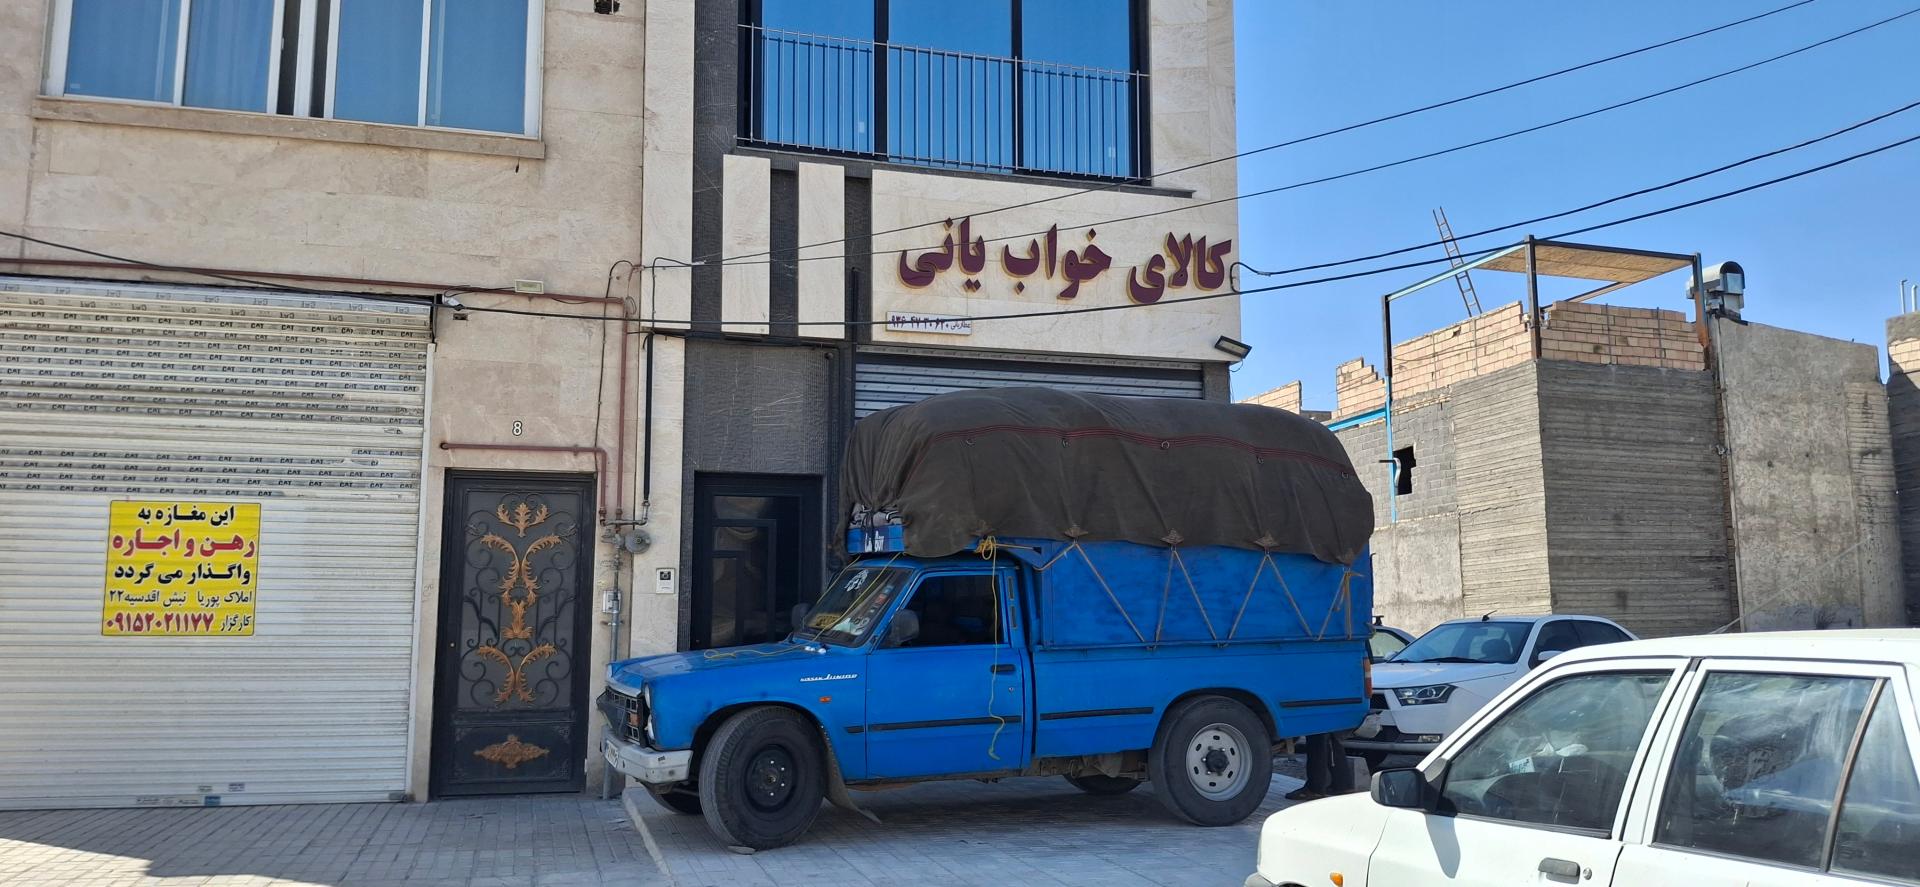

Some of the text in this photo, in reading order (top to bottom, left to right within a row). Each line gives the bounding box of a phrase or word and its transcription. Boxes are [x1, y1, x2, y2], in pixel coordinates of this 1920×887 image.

[1002, 223, 1112, 299] خواب
[1127, 231, 1232, 304] کالای
[512, 420, 522, 436] 8
[138, 504, 234, 526] این مغازه به
[112, 528, 255, 558] رهن و اجاره
[114, 564, 250, 584] واگذار می گردد
[163, 591, 186, 606] نبش
[197, 590, 220, 606] پوریا
[224, 590, 252, 602] املاک
[106, 612, 214, 632] ۰۹۱۵۲۰۲۱۱۷۷
